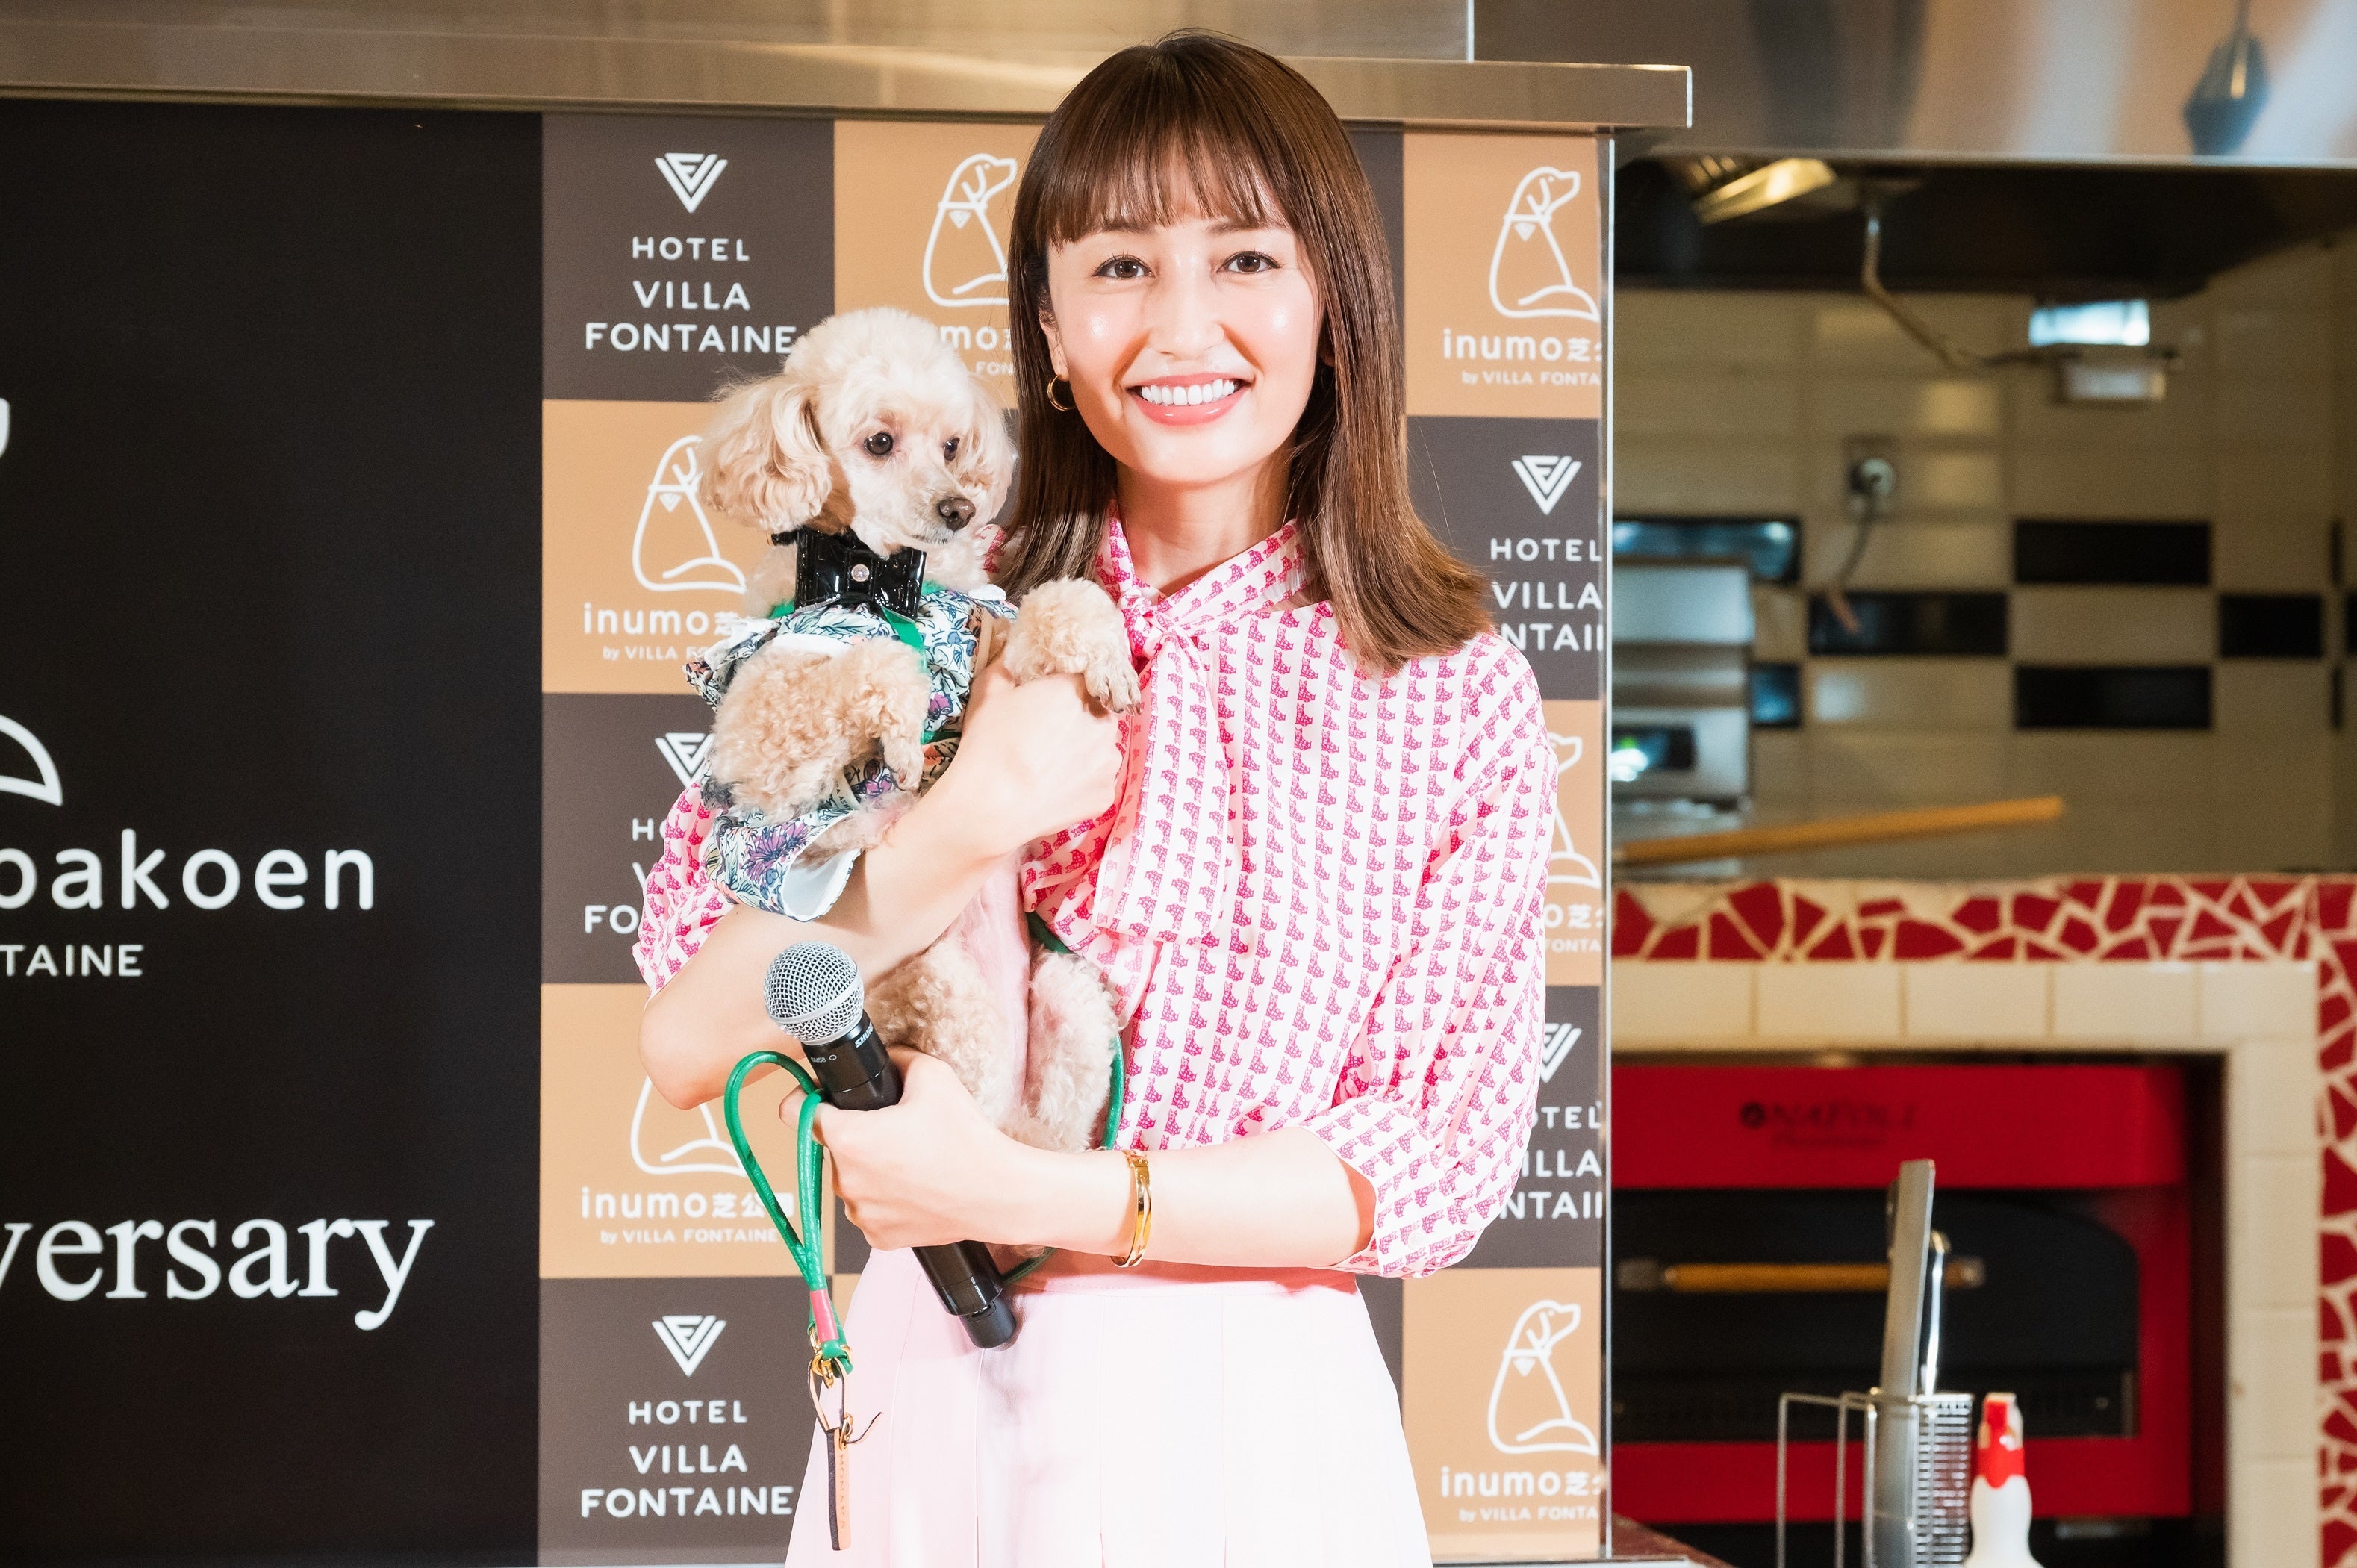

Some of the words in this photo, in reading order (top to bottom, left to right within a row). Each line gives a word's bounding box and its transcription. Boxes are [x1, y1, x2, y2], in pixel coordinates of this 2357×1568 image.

[632, 236, 750, 262] HOTEL
[632, 280, 750, 311] VILLA
[585, 322, 797, 353] FONTAINE
[1461, 370, 1479, 385] by
[1482, 370, 1534, 385] VILLA
[1490, 538, 1603, 561] HOTEL
[1492, 581, 1603, 610] VILLA
[603, 646, 620, 661] by
[624, 646, 678, 660] VILLA
[0, 944, 144, 977] TAINE
[1534, 1106, 1601, 1130] TEL
[600, 1230, 618, 1245] by
[622, 1229, 676, 1244] VILLA
[683, 1228, 778, 1243] FONTAINE
[629, 1400, 747, 1425] HOTEL
[629, 1443, 748, 1475] VILLA
[581, 1485, 794, 1518] FONTAINE
[1459, 1508, 1477, 1523] by
[1480, 1507, 1531, 1522] VILLA
